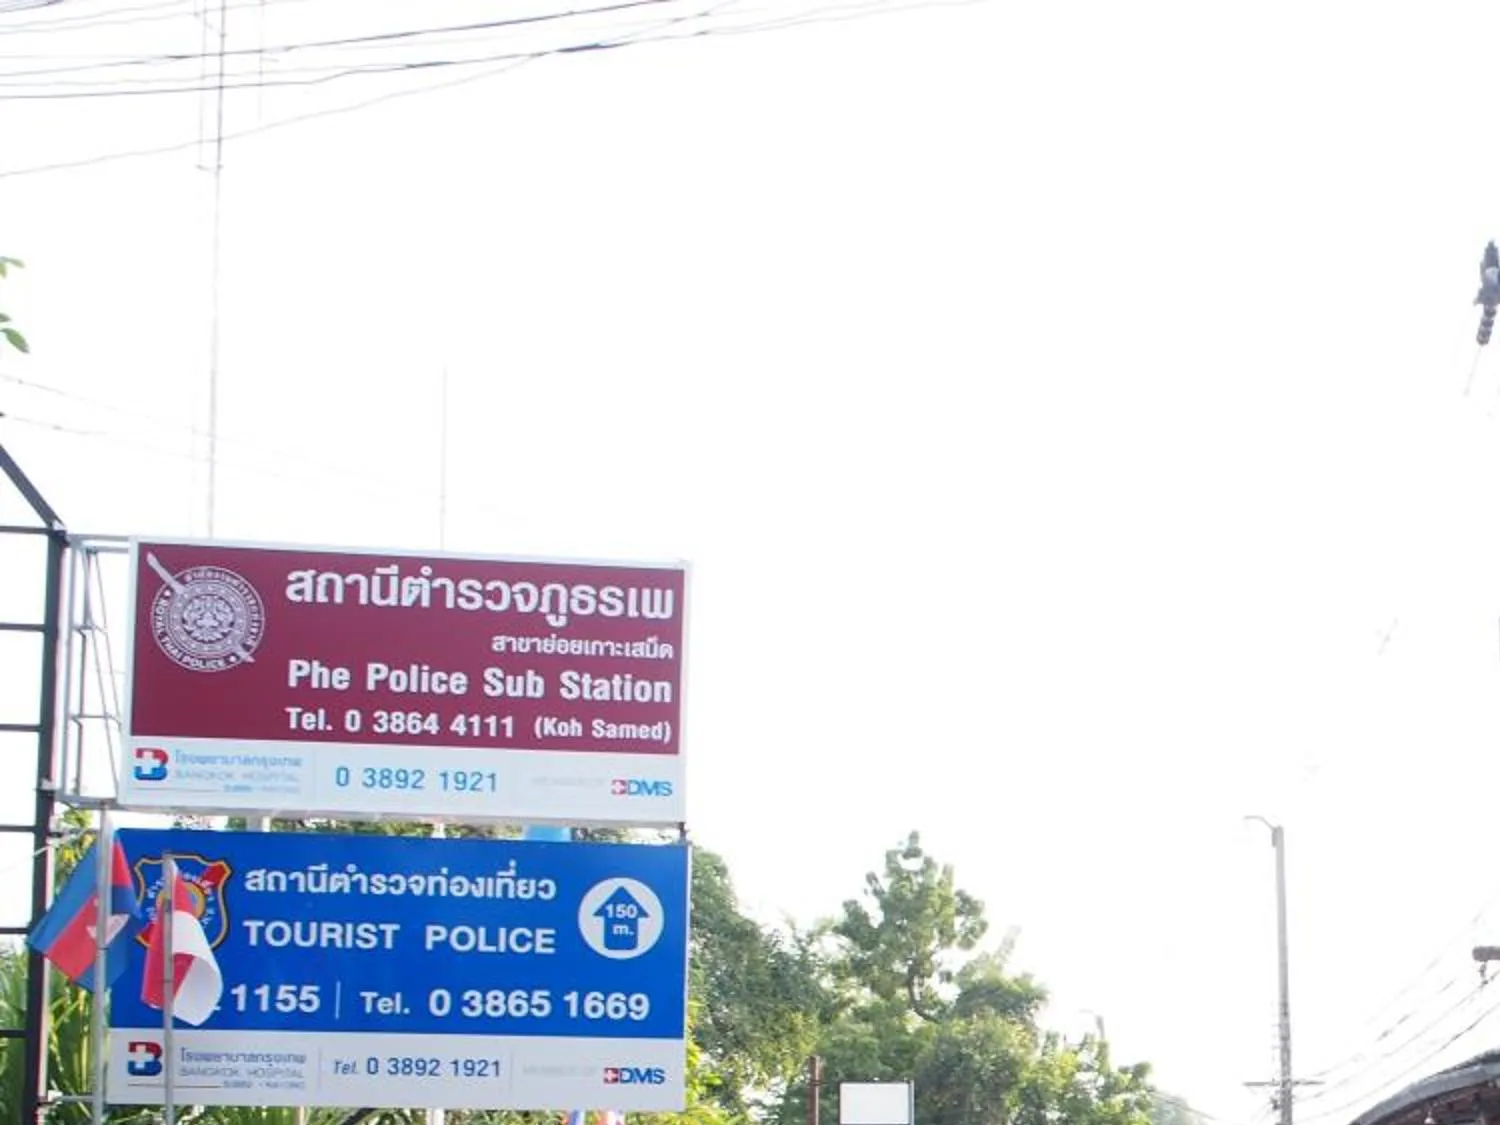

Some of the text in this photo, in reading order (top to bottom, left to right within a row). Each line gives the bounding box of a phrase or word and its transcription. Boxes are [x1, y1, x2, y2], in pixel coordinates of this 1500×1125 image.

[285, 564, 674, 627] สถานีตำรวจภูธรเพ
[491, 633, 674, 659] สาขาย่อยเกาะเสม็ด
[287, 658, 673, 703] Phe Police Sub Station
[285, 705, 673, 744] Tel. 0 3864 4111 (Koh Samed)
[335, 766, 498, 793] 0 3892 1921
[244, 859, 557, 900] สถานีตำรวจท่องเที่ยว
[604, 903, 639, 919] 150
[242, 919, 556, 954] TOURIST POLICE
[612, 924, 635, 937] m.
[230, 983, 651, 1021] 1155 Tel. 0 3865 1669
[366, 1057, 379, 1076] 0
[386, 1057, 441, 1078] 3892
[449, 1058, 501, 1078] 1921
